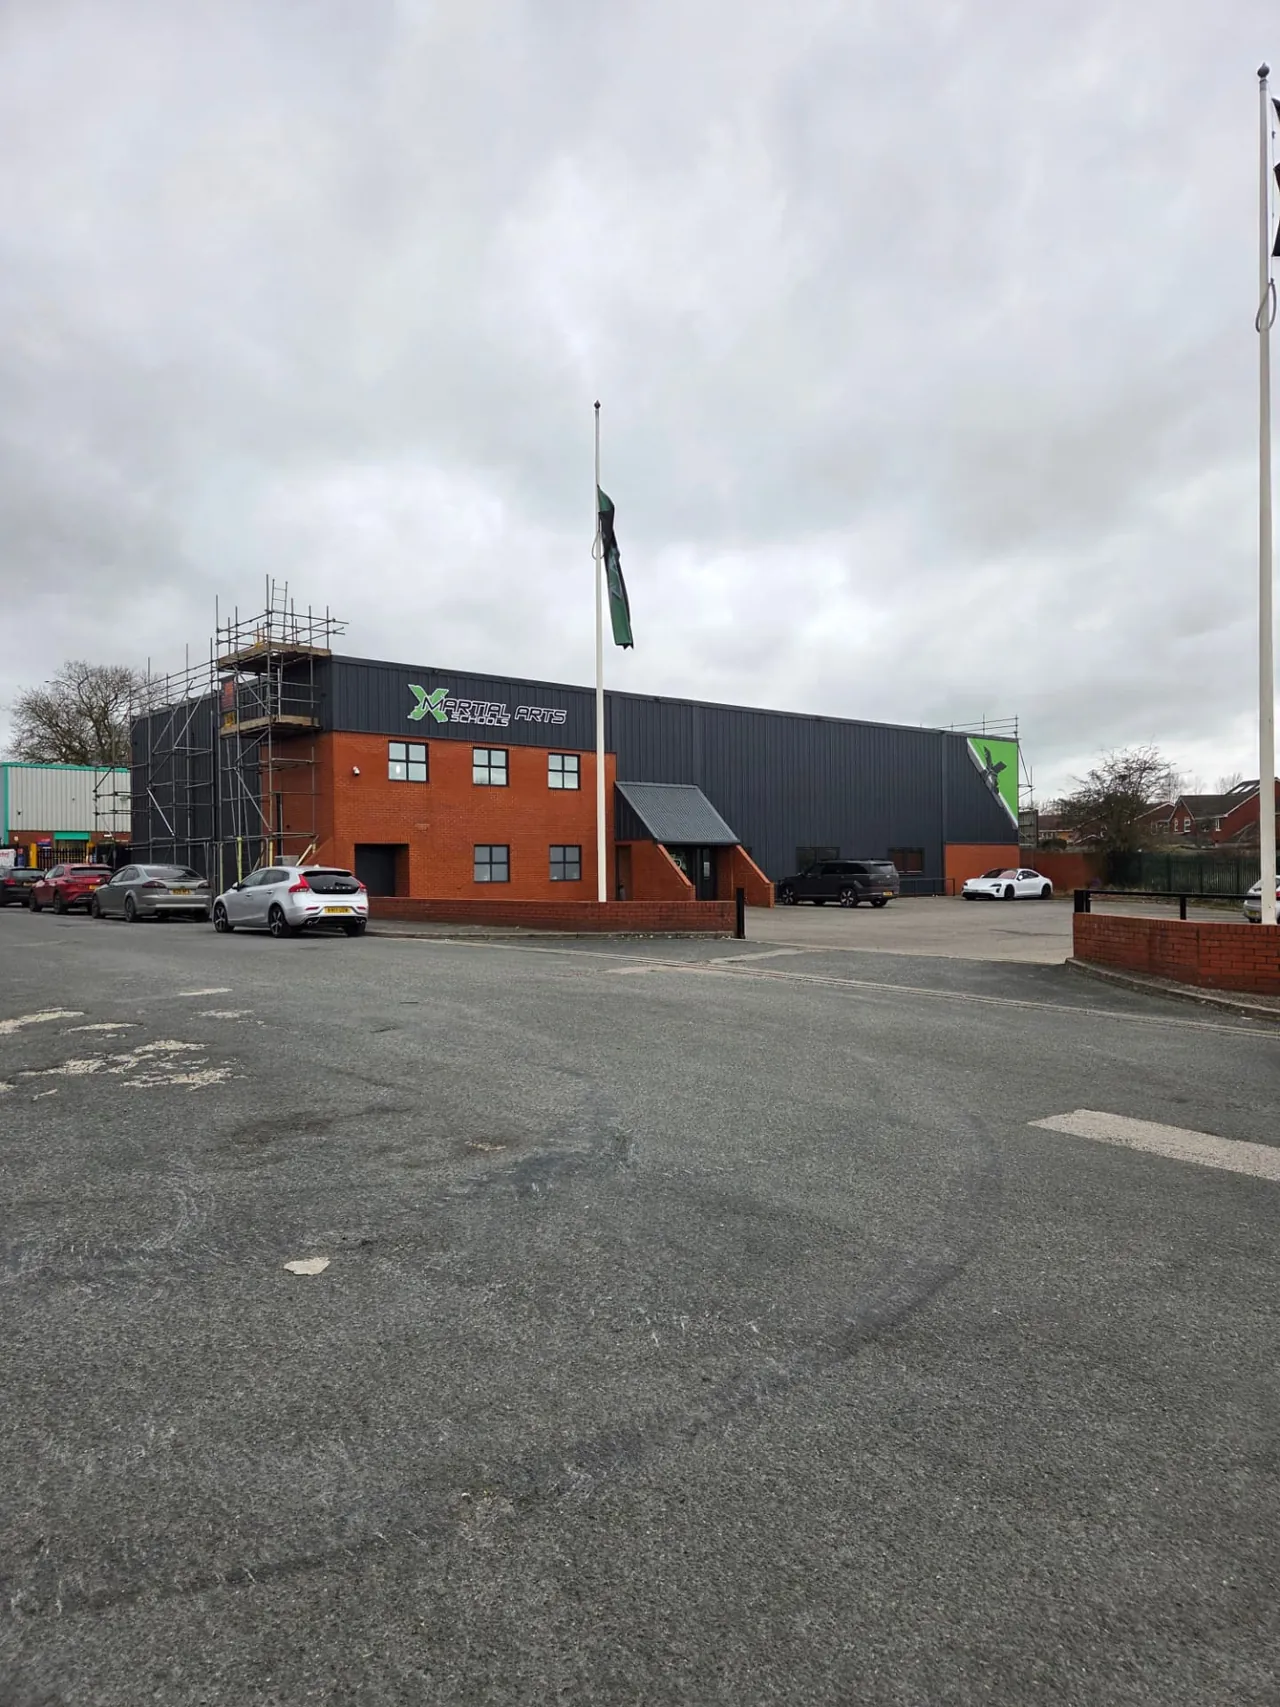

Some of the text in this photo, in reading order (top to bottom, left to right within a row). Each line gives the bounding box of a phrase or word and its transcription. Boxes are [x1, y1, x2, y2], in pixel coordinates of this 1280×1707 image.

[422, 697, 510, 718] MARTIAL
[514, 705, 567, 724] ARTS
[450, 712, 509, 727] SCHOOLS
